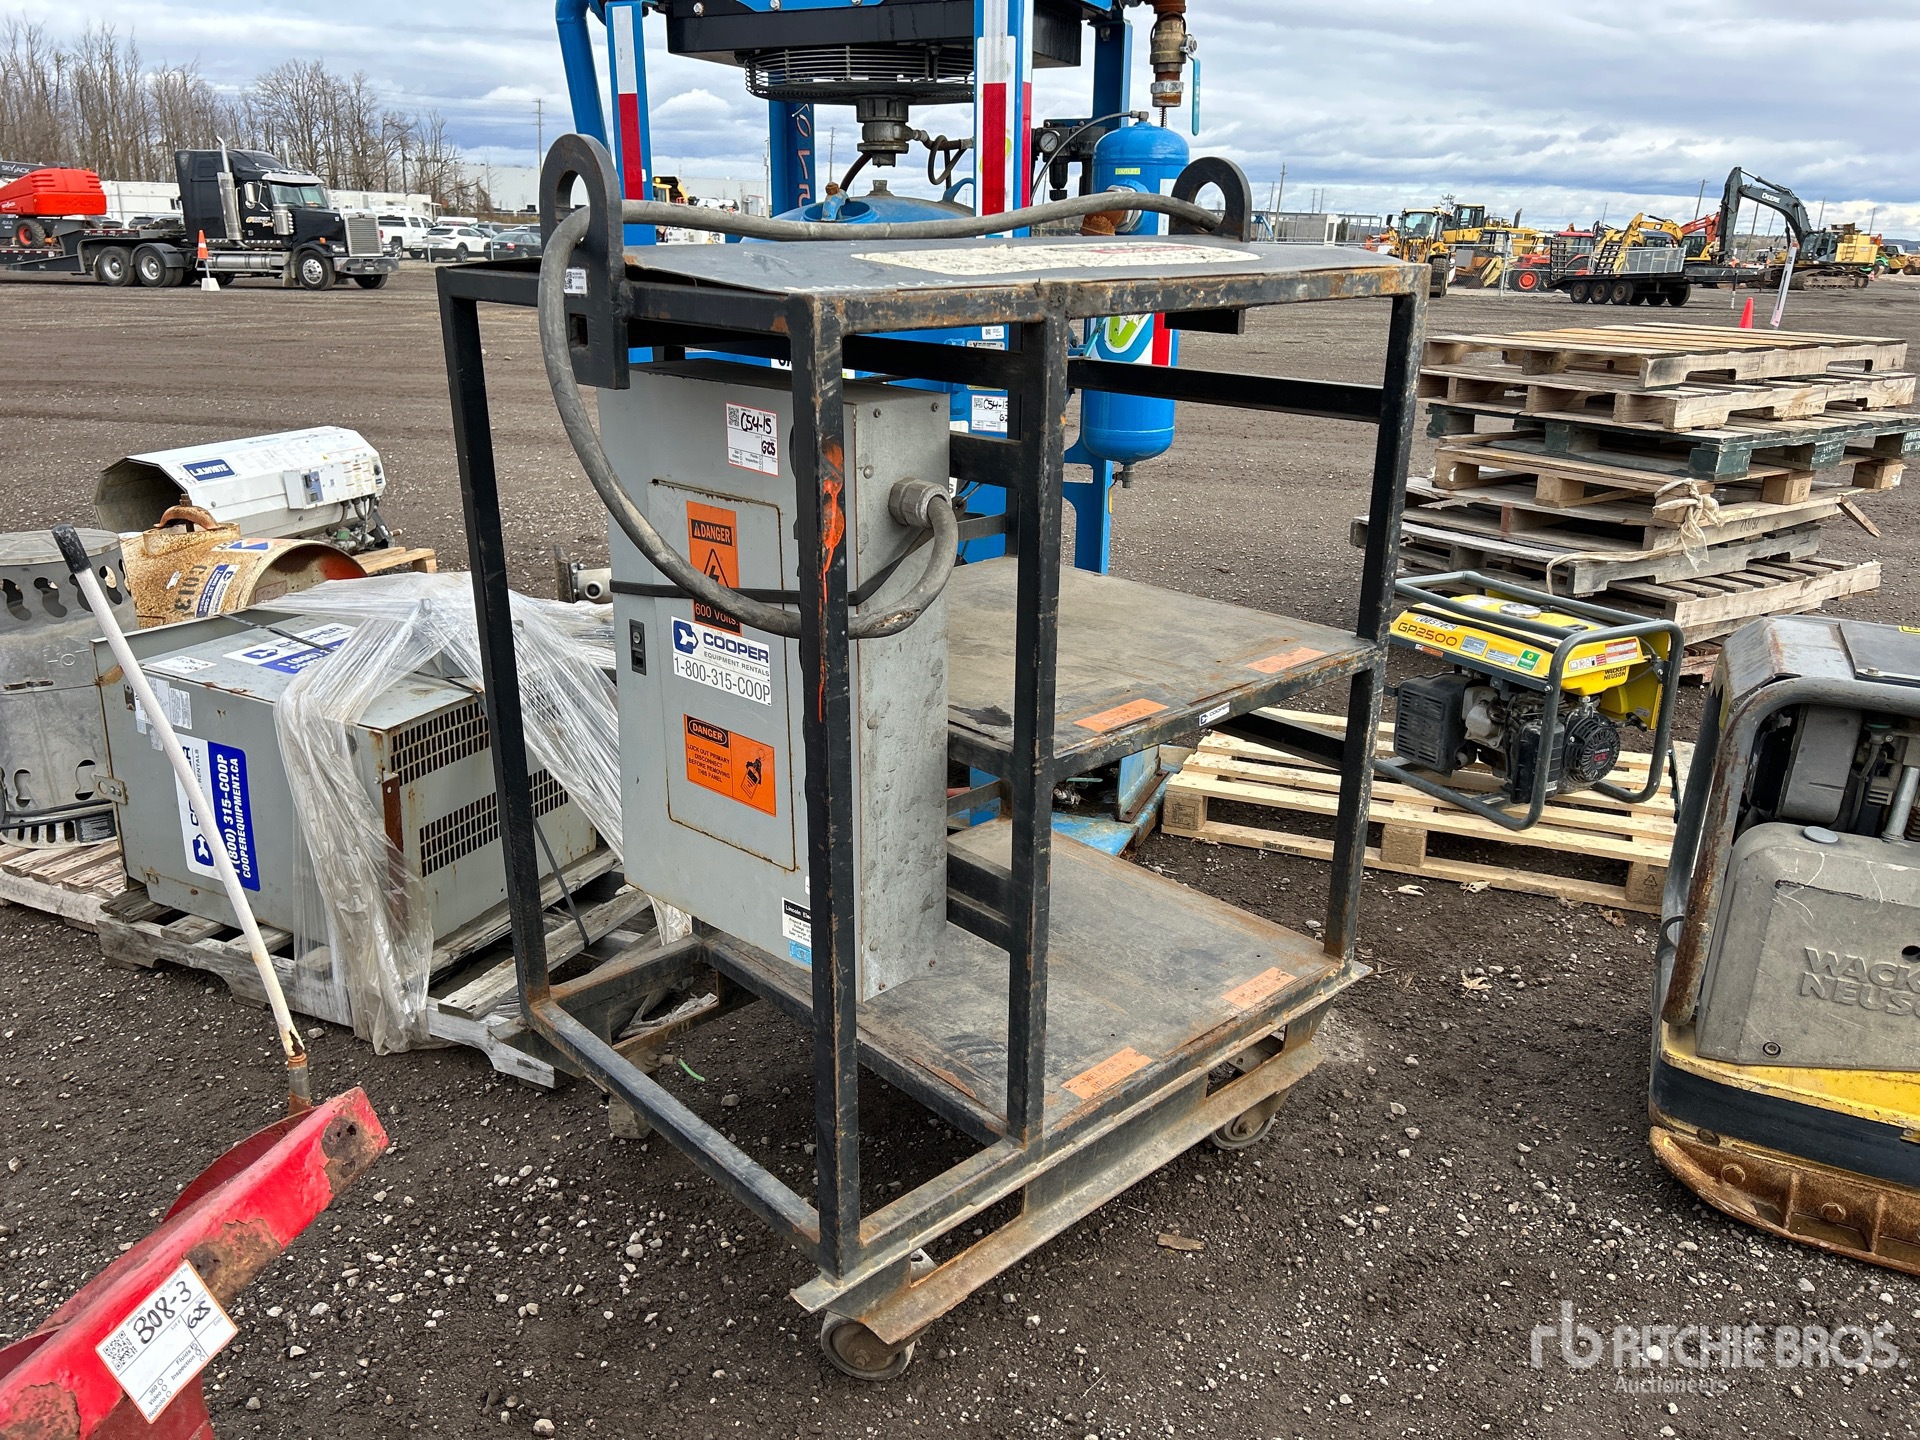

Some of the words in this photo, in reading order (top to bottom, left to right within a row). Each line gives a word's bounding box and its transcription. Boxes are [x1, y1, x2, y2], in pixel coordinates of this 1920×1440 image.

[700, 523, 731, 544] DANGER
[695, 603, 712, 618] 600
[1397, 621, 1458, 647] GP2500
[702, 632, 769, 664] COOPER
[703, 651, 740, 667] EQUIPMENT
[741, 662, 770, 677] RENTALS
[1604, 666, 1627, 674] WACKER
[674, 656, 771, 702] 1-800-315-COOP
[1603, 671, 1626, 681] NEUSON
[692, 722, 723, 742] DANGER
[688, 744, 699, 752] LOCK
[699, 748, 709, 757] OUT
[710, 750, 730, 764] PRIMARY
[694, 753, 723, 769] DISCONNECT
[194, 748, 203, 783] RENTALS
[688, 758, 707, 769] BEFORE
[707, 764, 730, 779] REMOVING
[697, 768, 708, 777] THIS
[708, 771, 723, 783] PANEL
[216, 753, 234, 825] 315-COOP
[229, 757, 252, 879] COOPEREQUIPMENT.CA
[785, 904, 801, 916] Lincoln
[133, 1280, 192, 1345] B08-3
[175, 1348, 192, 1365] Fluids
[170, 1354, 196, 1381] Inspection
[147, 1391, 162, 1406] Video
[148, 1384, 159, 1396] 360
[147, 1396, 167, 1418] Rephoto
